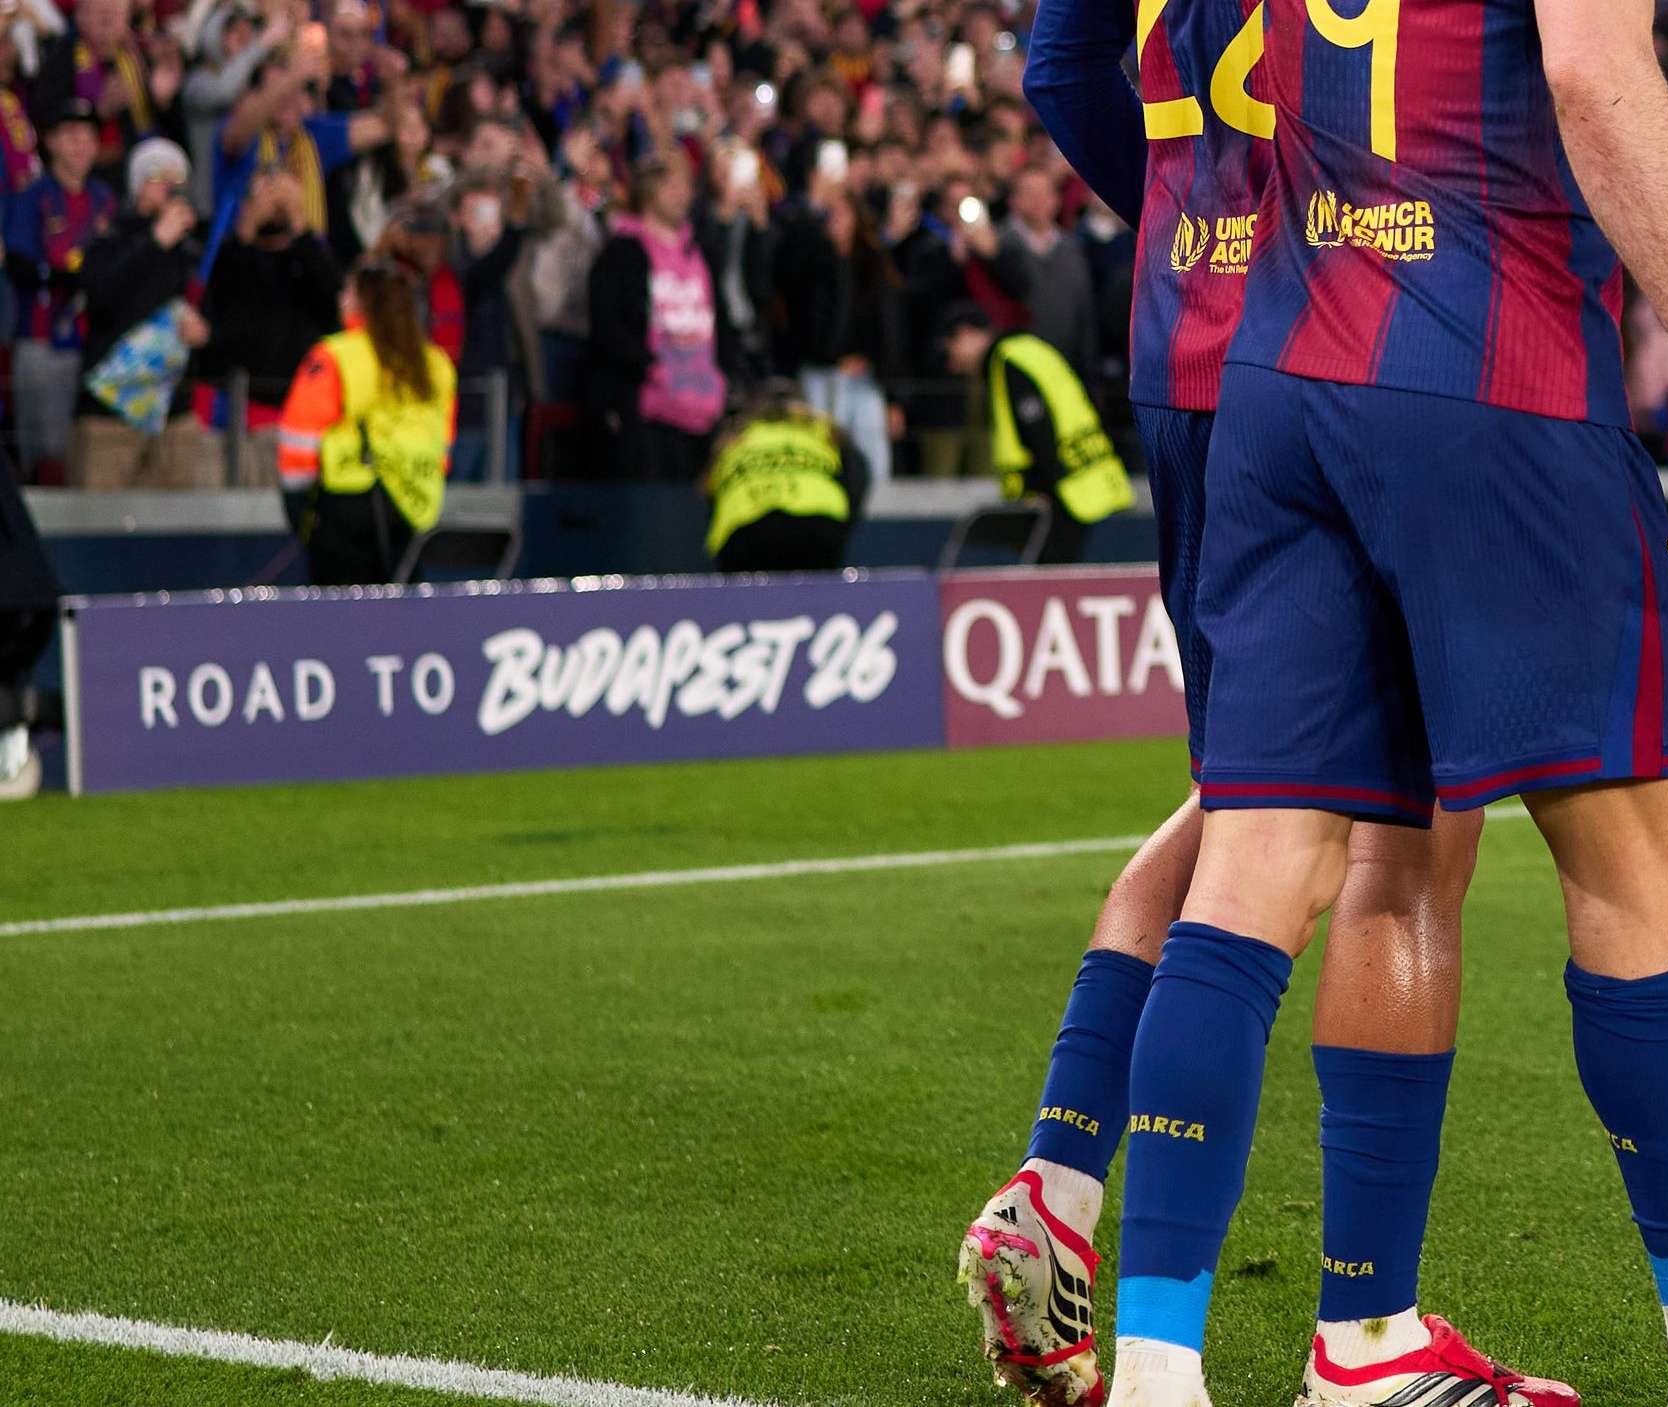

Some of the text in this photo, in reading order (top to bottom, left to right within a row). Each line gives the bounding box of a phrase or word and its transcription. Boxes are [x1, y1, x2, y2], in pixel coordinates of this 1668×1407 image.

[138, 611, 898, 736] ROAD TO BUDAPEST 26
[1039, 1106, 1100, 1137] BARÇA
